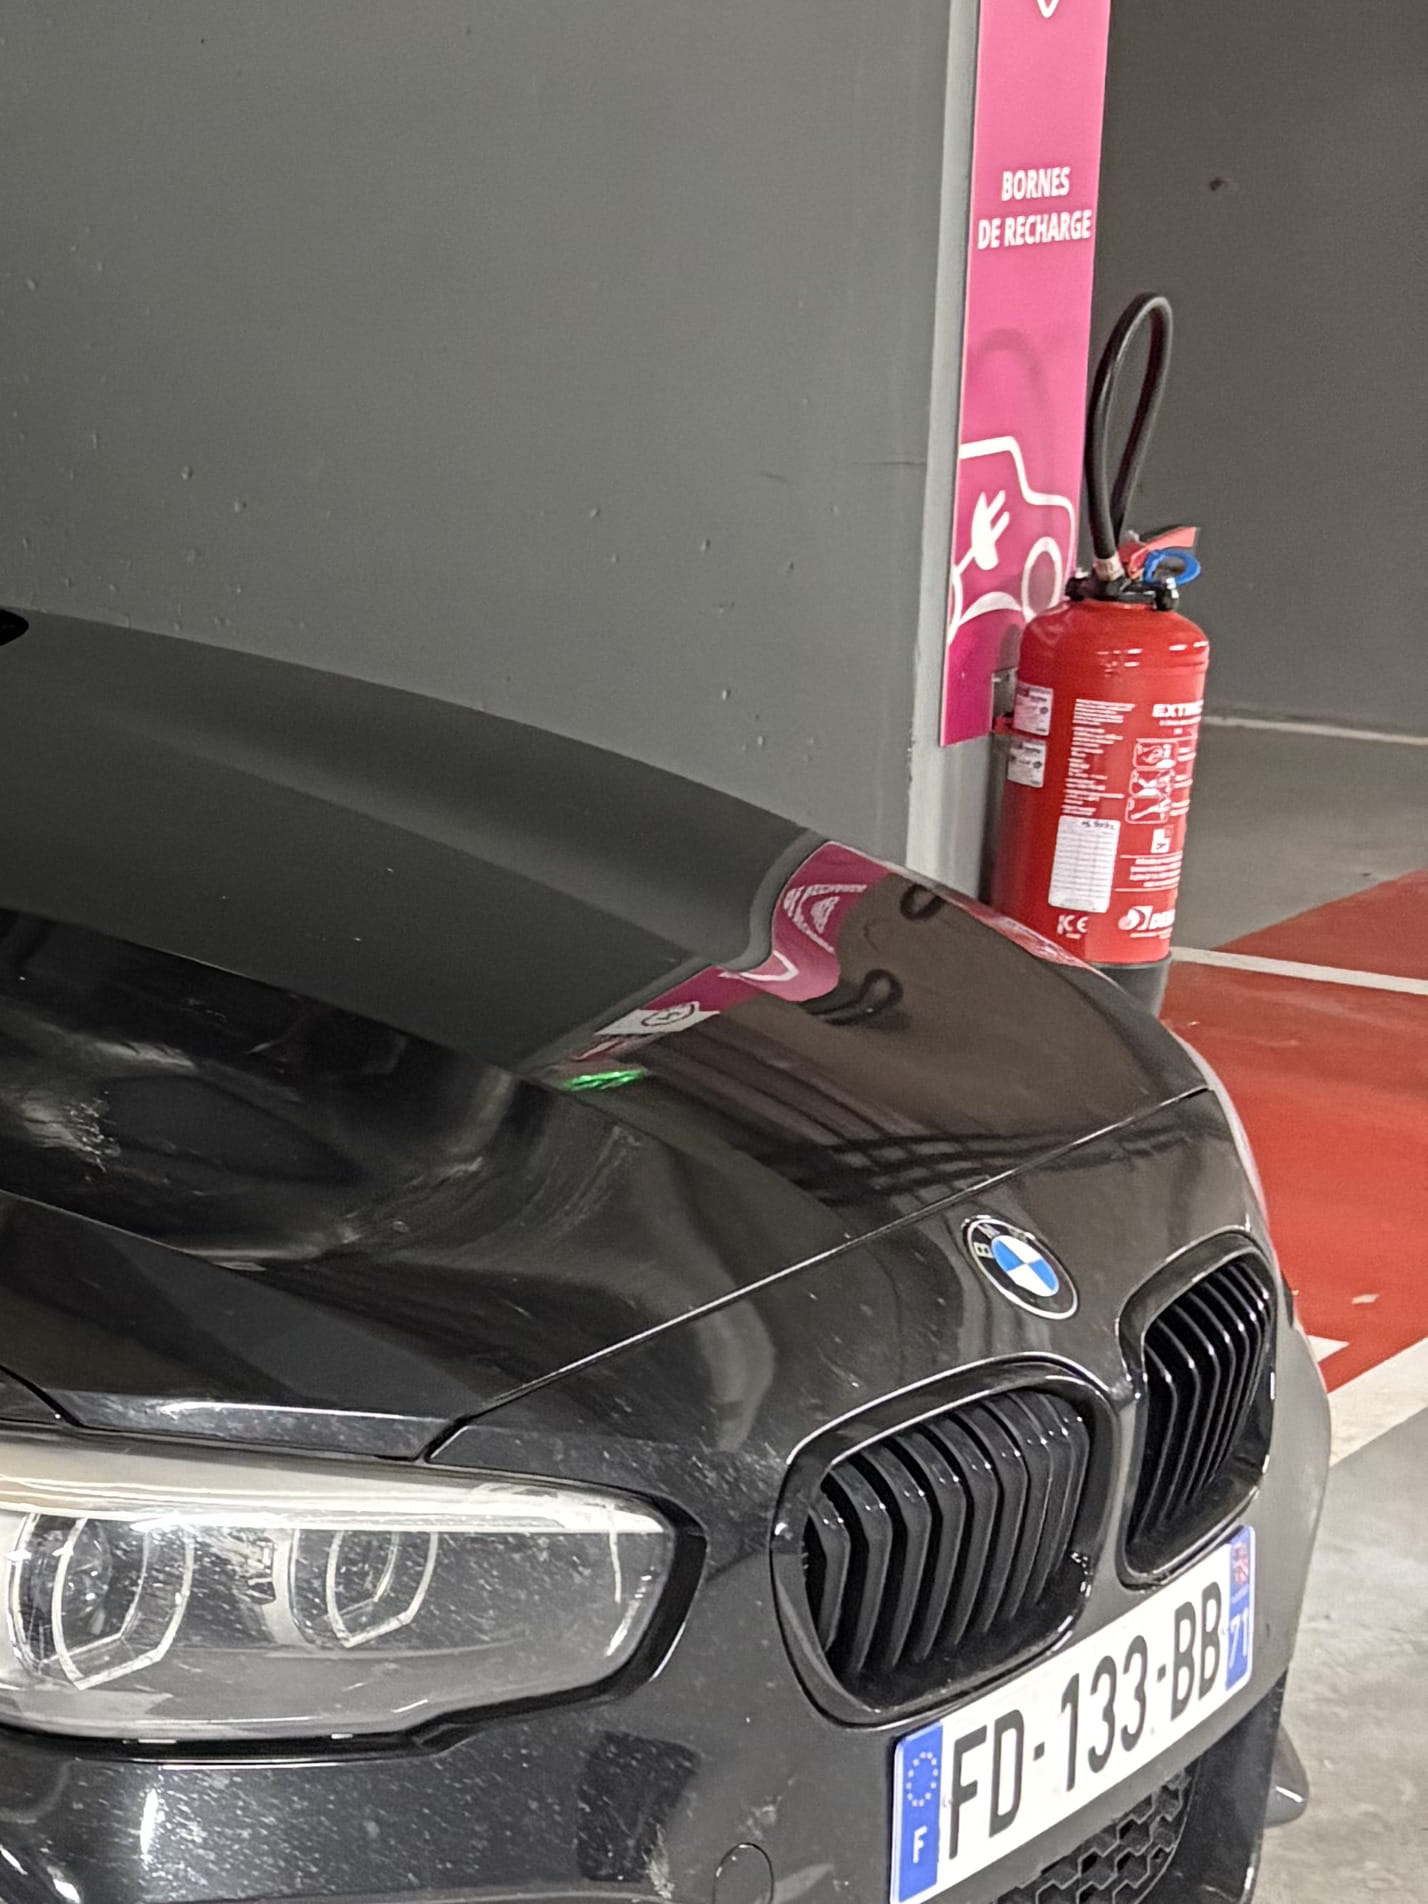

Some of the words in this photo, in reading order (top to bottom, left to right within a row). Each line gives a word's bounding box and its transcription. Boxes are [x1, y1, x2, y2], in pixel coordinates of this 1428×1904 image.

[1001, 166, 1071, 201] BORNES
[977, 217, 1001, 250] DE
[1003, 209, 1092, 247] RECHARGE
[1228, 1606, 1249, 1670] 71
[948, 1581, 1222, 1860] FD-133-BB
[912, 1825, 928, 1864] F
